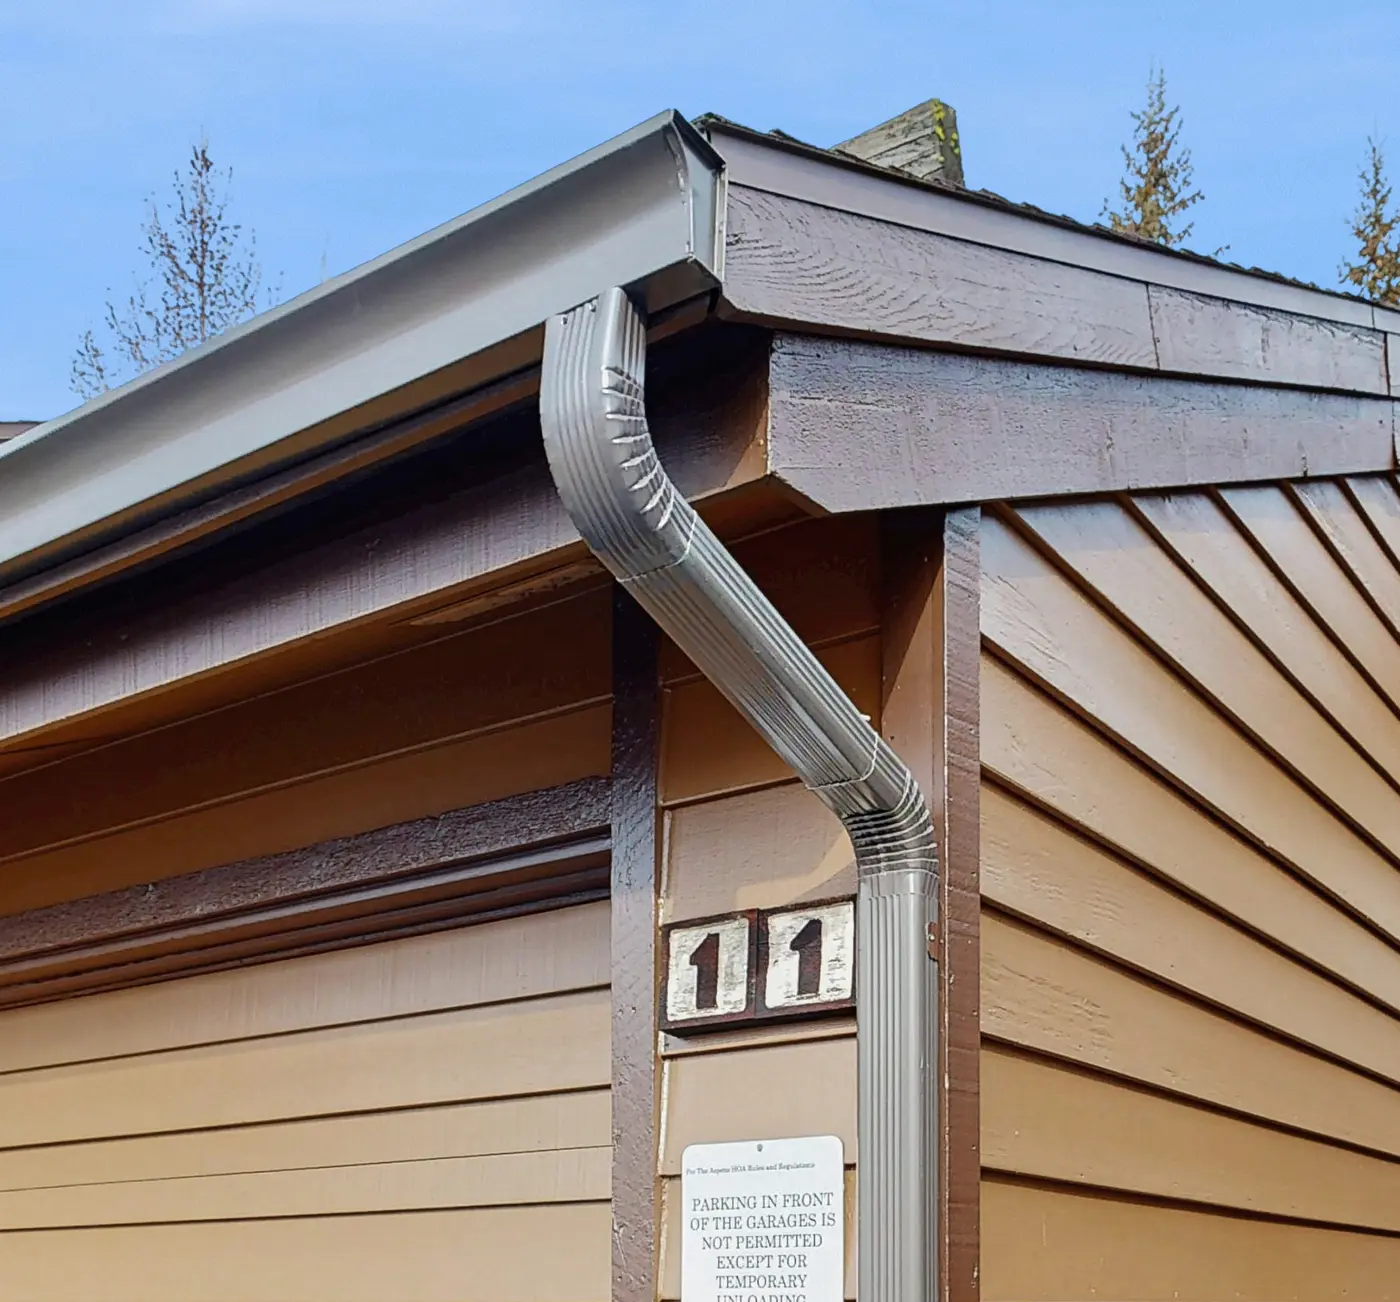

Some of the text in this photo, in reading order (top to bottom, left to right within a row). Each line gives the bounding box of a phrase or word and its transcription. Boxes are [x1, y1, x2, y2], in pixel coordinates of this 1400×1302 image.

[731, 1164, 746, 1173] HOA
[748, 1164, 764, 1172] Rules
[766, 1163, 777, 1171] and
[779, 1161, 815, 1171] Regulations
[692, 1192, 834, 1211] PARKING IN FRONT
[690, 1212, 836, 1230] OF THE GARAGES IS
[702, 1233, 823, 1249] NOT PERMITTED
[717, 1254, 807, 1269] EXCEPT FOR
[716, 1274, 807, 1288] TEMPORARY
